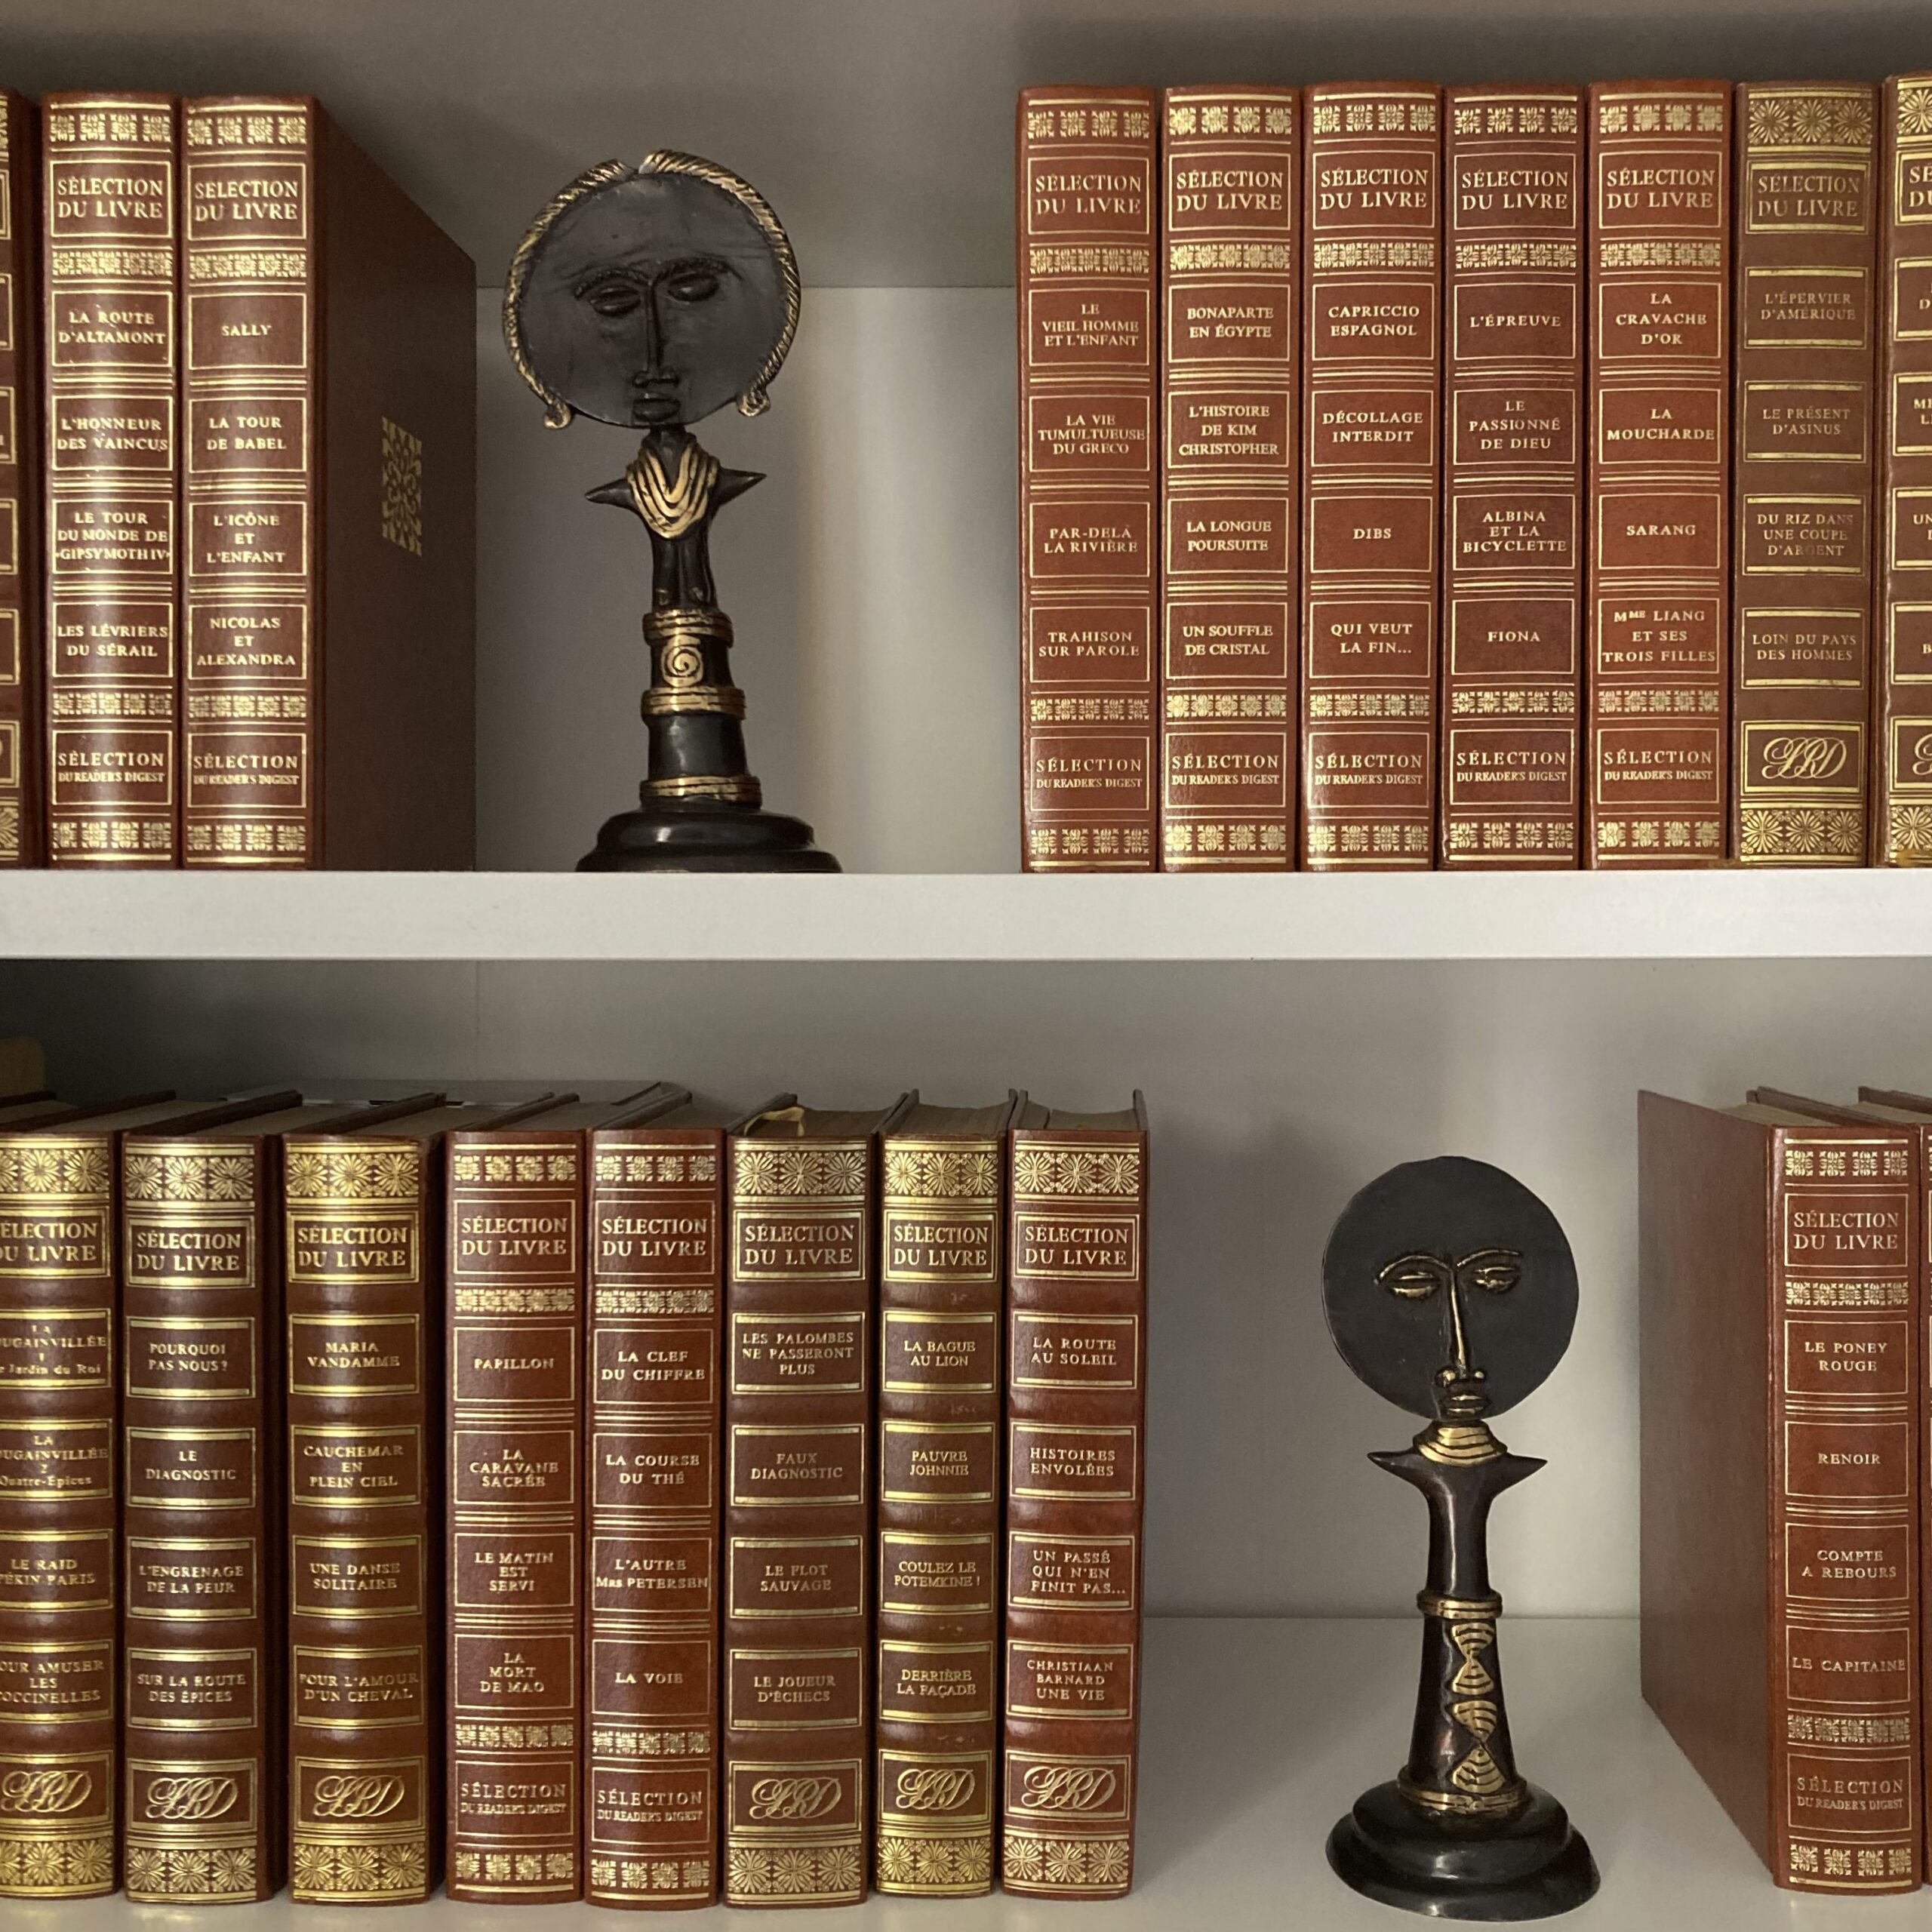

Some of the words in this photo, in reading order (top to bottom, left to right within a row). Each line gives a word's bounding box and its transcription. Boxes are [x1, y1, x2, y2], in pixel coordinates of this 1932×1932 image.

[1177, 168, 1283, 189] SÉLECTION
[1321, 167, 1429, 187] SÉLECTION
[1462, 169, 1568, 189] SÉLECTION
[1607, 168, 1715, 187] SÉLECTION
[1035, 174, 1142, 193] SÉLECTION
[1035, 198, 1066, 215] DU
[1077, 198, 1140, 214] LIVRE
[1177, 195, 1208, 211] DU
[1217, 193, 1282, 210] LIVRE
[1321, 193, 1352, 210] DU
[1361, 192, 1427, 208] LIVRE
[1462, 195, 1493, 211] DU
[1503, 193, 1568, 210] LIVRE
[1607, 192, 1638, 209] DU
[1647, 192, 1713, 208] LIVRE
[57, 202, 88, 219] DU
[97, 202, 163, 219] LIVRE
[195, 206, 224, 221] DU
[233, 204, 297, 220] LIVRE
[1650, 294, 1672, 304] LA
[1081, 304, 1100, 315] LE
[1188, 307, 1274, 319] BONAPARTE
[1328, 306, 1420, 318] CAPRICCIO
[69, 311, 90, 325] LA
[98, 312, 155, 325] ROUTE
[1470, 314, 1561, 328] L'ÉPREUVE
[1616, 313, 1707, 325] CRAVACHE
[222, 325, 271, 337] SALLY
[1042, 321, 1078, 332] VIEIL
[1083, 320, 1139, 331] HOMME
[1190, 327, 1210, 338] EN
[1215, 323, 1272, 338] ÉGYPTE
[1331, 325, 1417, 337] ESPAGNOL
[59, 331, 166, 345] D'ALTAMONT
[1044, 335, 1063, 346] ET
[1067, 334, 1138, 346] L'ENFANT
[1641, 334, 1682, 346] D'OR
[1189, 406, 1269, 417] L'HISTOIRE
[1506, 401, 1525, 412] LE
[1322, 410, 1423, 424] DÉCOLLAGE
[1651, 409, 1672, 419] LA
[210, 417, 229, 429] LA
[238, 417, 281, 429] TOUR
[1469, 417, 1561, 432] PASSIONNÉ
[1201, 426, 1222, 436] DE
[1228, 425, 1257, 435] KIM
[1333, 430, 1414, 442] INTERDIT
[1607, 429, 1715, 440] MOUCHARDE
[207, 438, 227, 451] DE
[235, 437, 287, 450] BABEL
[1179, 443, 1279, 456] CHRISTOPHER
[1481, 438, 1503, 450] DE
[1510, 438, 1552, 449] DIEU
[214, 512, 279, 527] L'ICÔNE
[1483, 511, 1546, 523] ALBINA
[1353, 528, 1392, 540] DIBS
[1490, 525, 1512, 537] ET
[1518, 525, 1540, 537] LA
[1626, 525, 1696, 536] SARANG
[235, 534, 255, 545] ET
[1463, 540, 1567, 553] BICYCLETTE
[207, 551, 286, 564] L'ENFANT
[210, 617, 281, 629] NICOLAS
[1331, 623, 1362, 635] QUI
[1369, 623, 1413, 635] VEUT
[57, 625, 84, 637] LES
[91, 623, 168, 638] LÉVRIERS
[1183, 626, 1204, 637] UN
[1209, 626, 1273, 637] SOUFFLE
[234, 635, 254, 647] ET
[1048, 631, 1132, 643] TRAHISON
[1487, 632, 1541, 642] FIONA
[1752, 634, 1789, 645] LOIN
[1795, 634, 1817, 645] DU
[1822, 635, 1856, 645] PAYS
[67, 645, 90, 657] DU
[97, 642, 158, 657] SÉRAIL
[1038, 646, 1070, 657] SUR
[1076, 645, 1140, 657] PAROLE
[1185, 645, 1206, 656] DE
[1210, 644, 1269, 655] CRISTAL
[1340, 642, 1361, 654] LA
[197, 654, 296, 666] ALEXANDRA
[1757, 650, 1785, 660] DES
[1792, 650, 1852, 660] HOMMES
[461, 1216, 568, 1234] SÉLECTION
[602, 1217, 707, 1235] SÉLECTION
[1794, 1211, 1899, 1229] SÉLECTION
[746, 1223, 855, 1243] SÉLECTION
[894, 1223, 989, 1244] SÉLECTION
[1025, 1224, 1128, 1244] SÉLECTION
[137, 1230, 242, 1250] SÉLECTION
[1793, 1234, 1825, 1250] DU
[1835, 1235, 1898, 1250] LIVRE
[462, 1240, 492, 1256] DU
[500, 1240, 567, 1256] LIVRE
[602, 1241, 632, 1257] DU
[641, 1241, 706, 1257] LIVRE
[745, 1248, 776, 1265] DU
[786, 1248, 853, 1265] LIVRE
[894, 1249, 920, 1265] DU
[928, 1250, 987, 1266] LIVRE
[1025, 1248, 1055, 1265] DU
[1063, 1250, 1127, 1265] LIVRE
[137, 1255, 165, 1271] DU
[174, 1256, 239, 1272] LIVRE
[743, 1333, 768, 1344] LES
[777, 1333, 854, 1344] PALOMBES
[1033, 1337, 1053, 1349] LA
[1061, 1339, 1117, 1351] ROUTE
[904, 1340, 921, 1352] LA
[928, 1341, 976, 1352] BAGUE
[1804, 1342, 1826, 1352] LE
[1834, 1343, 1887, 1354] PONEY
[617, 1352, 638, 1363] LA
[648, 1351, 688, 1363] CLEF
[742, 1348, 761, 1359] NE
[770, 1347, 854, 1359] PASSERONT
[1031, 1352, 1054, 1363] AU
[1060, 1354, 1117, 1366] SOLEIL
[474, 1358, 554, 1370] PAPILLON
[911, 1355, 931, 1366] AU
[935, 1355, 968, 1366] LION
[1819, 1361, 1878, 1371] ROUGE
[601, 1369, 625, 1380] DU
[633, 1369, 706, 1381] CHIFFRE
[780, 1364, 815, 1375] PLUS
[179, 1451, 197, 1461] LE
[912, 1451, 968, 1463] PAUVRE
[1030, 1447, 1115, 1461] HISTOIRES
[1818, 1453, 1881, 1465] RENOIR
[146, 1469, 235, 1481] DIAGNOSTIC
[909, 1464, 969, 1475] JOHNNIE
[1031, 1463, 1114, 1476] ENVOLÉES
[475, 1552, 494, 1564] LE
[499, 1552, 553, 1564] MATIN
[1033, 1550, 1057, 1561] UN
[1064, 1550, 1110, 1564] PASSÉ
[499, 1567, 528, 1578] EST
[1032, 1567, 1061, 1578] QUI
[1070, 1567, 1110, 1579] N'EN
[489, 1580, 535, 1592] SERVI
[1792, 1657, 1812, 1669] LE
[1821, 1660, 1906, 1672] CAPITAINE
[615, 1673, 636, 1683] LA
[645, 1673, 684, 1684] VOIE
[901, 1668, 972, 1681] DERRIÈRE
[897, 1683, 915, 1694] LA
[920, 1684, 976, 1698] FAÇADE
